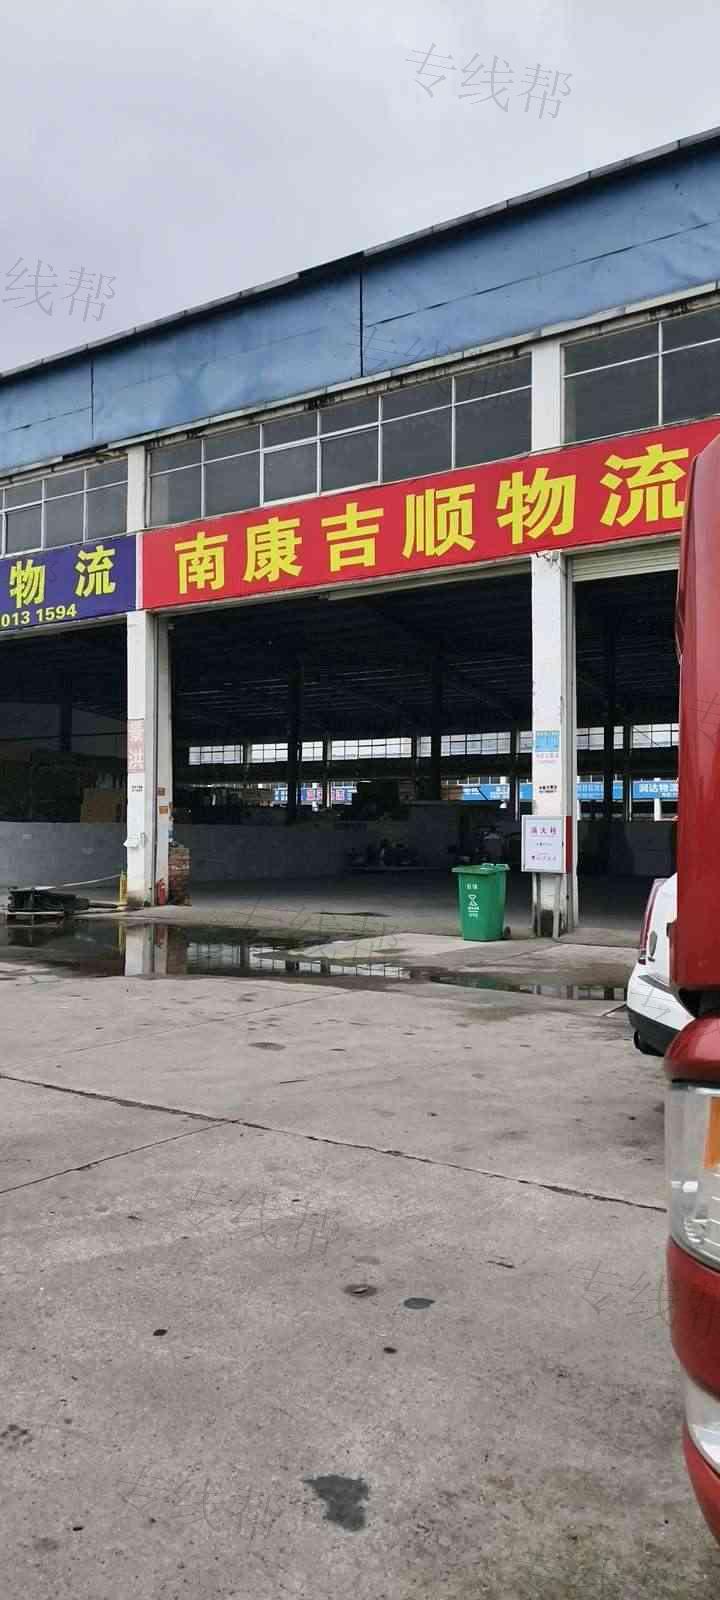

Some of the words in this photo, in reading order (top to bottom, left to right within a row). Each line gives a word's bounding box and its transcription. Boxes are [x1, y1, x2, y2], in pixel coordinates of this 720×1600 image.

[173, 443, 691, 596] 南康吉顺物流
[8, 543, 117, 610] 物流
[35, 602, 78, 624] 1594
